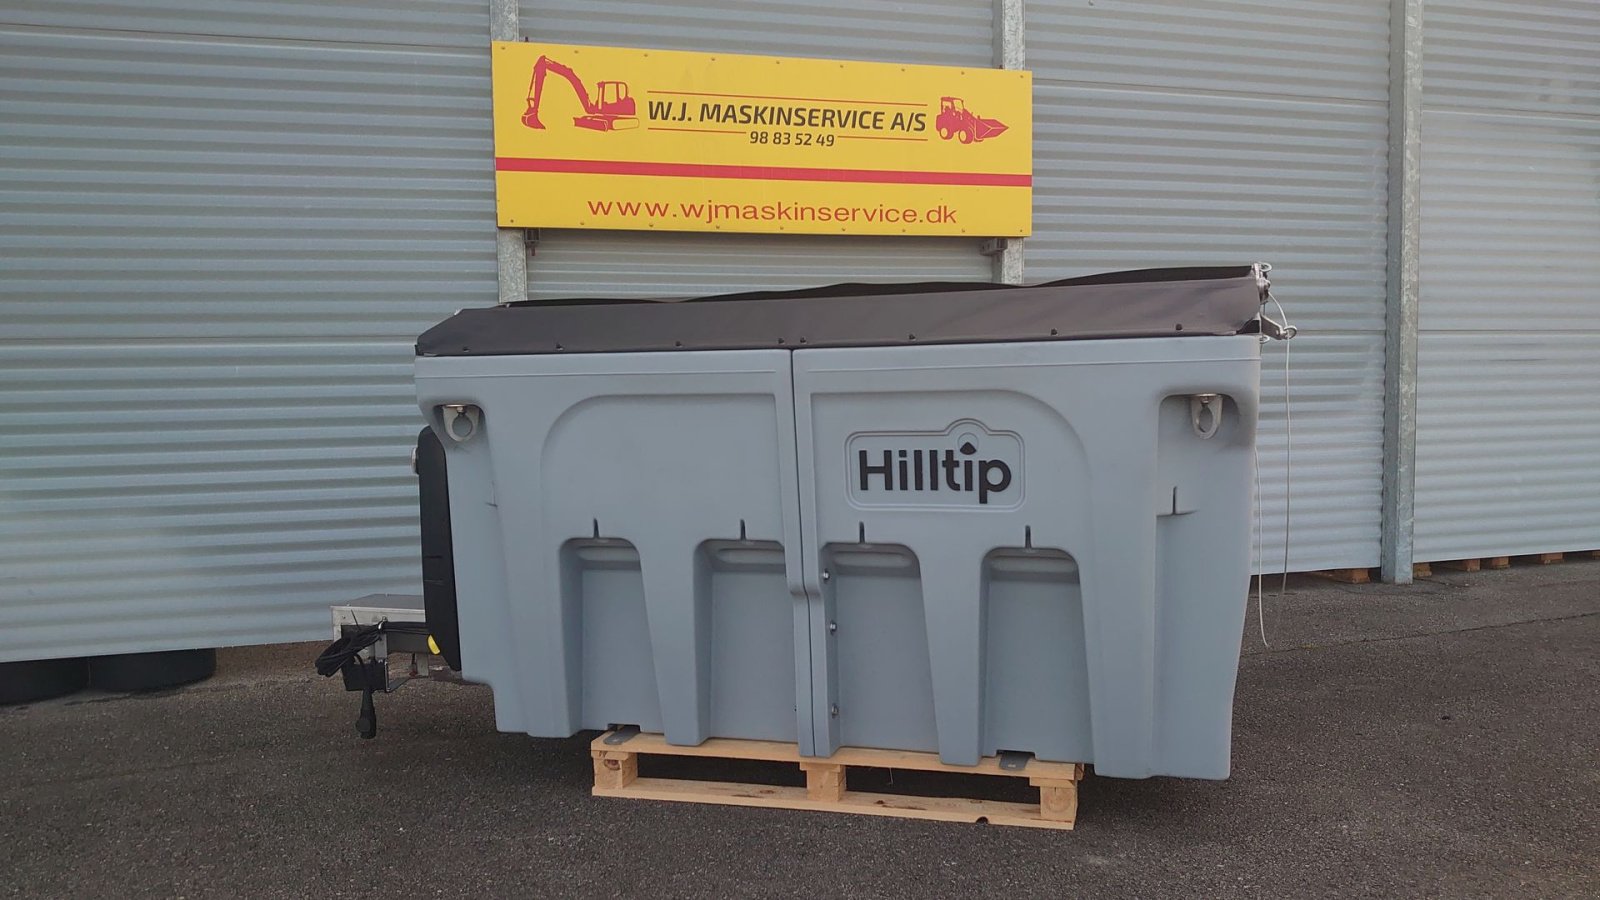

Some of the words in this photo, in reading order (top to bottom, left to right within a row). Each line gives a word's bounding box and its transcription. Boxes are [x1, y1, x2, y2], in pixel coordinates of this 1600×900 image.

[648, 100, 692, 121] W.J.
[699, 103, 885, 130] MASKINSERVICE
[889, 112, 927, 132] A/S
[749, 131, 768, 144] 98
[772, 132, 791, 145] 83
[794, 133, 812, 146] 52
[816, 134, 835, 147] 49
[587, 199, 957, 224] www.wjmaskinservice.dk
[859, 441, 1011, 504] Hilltip
